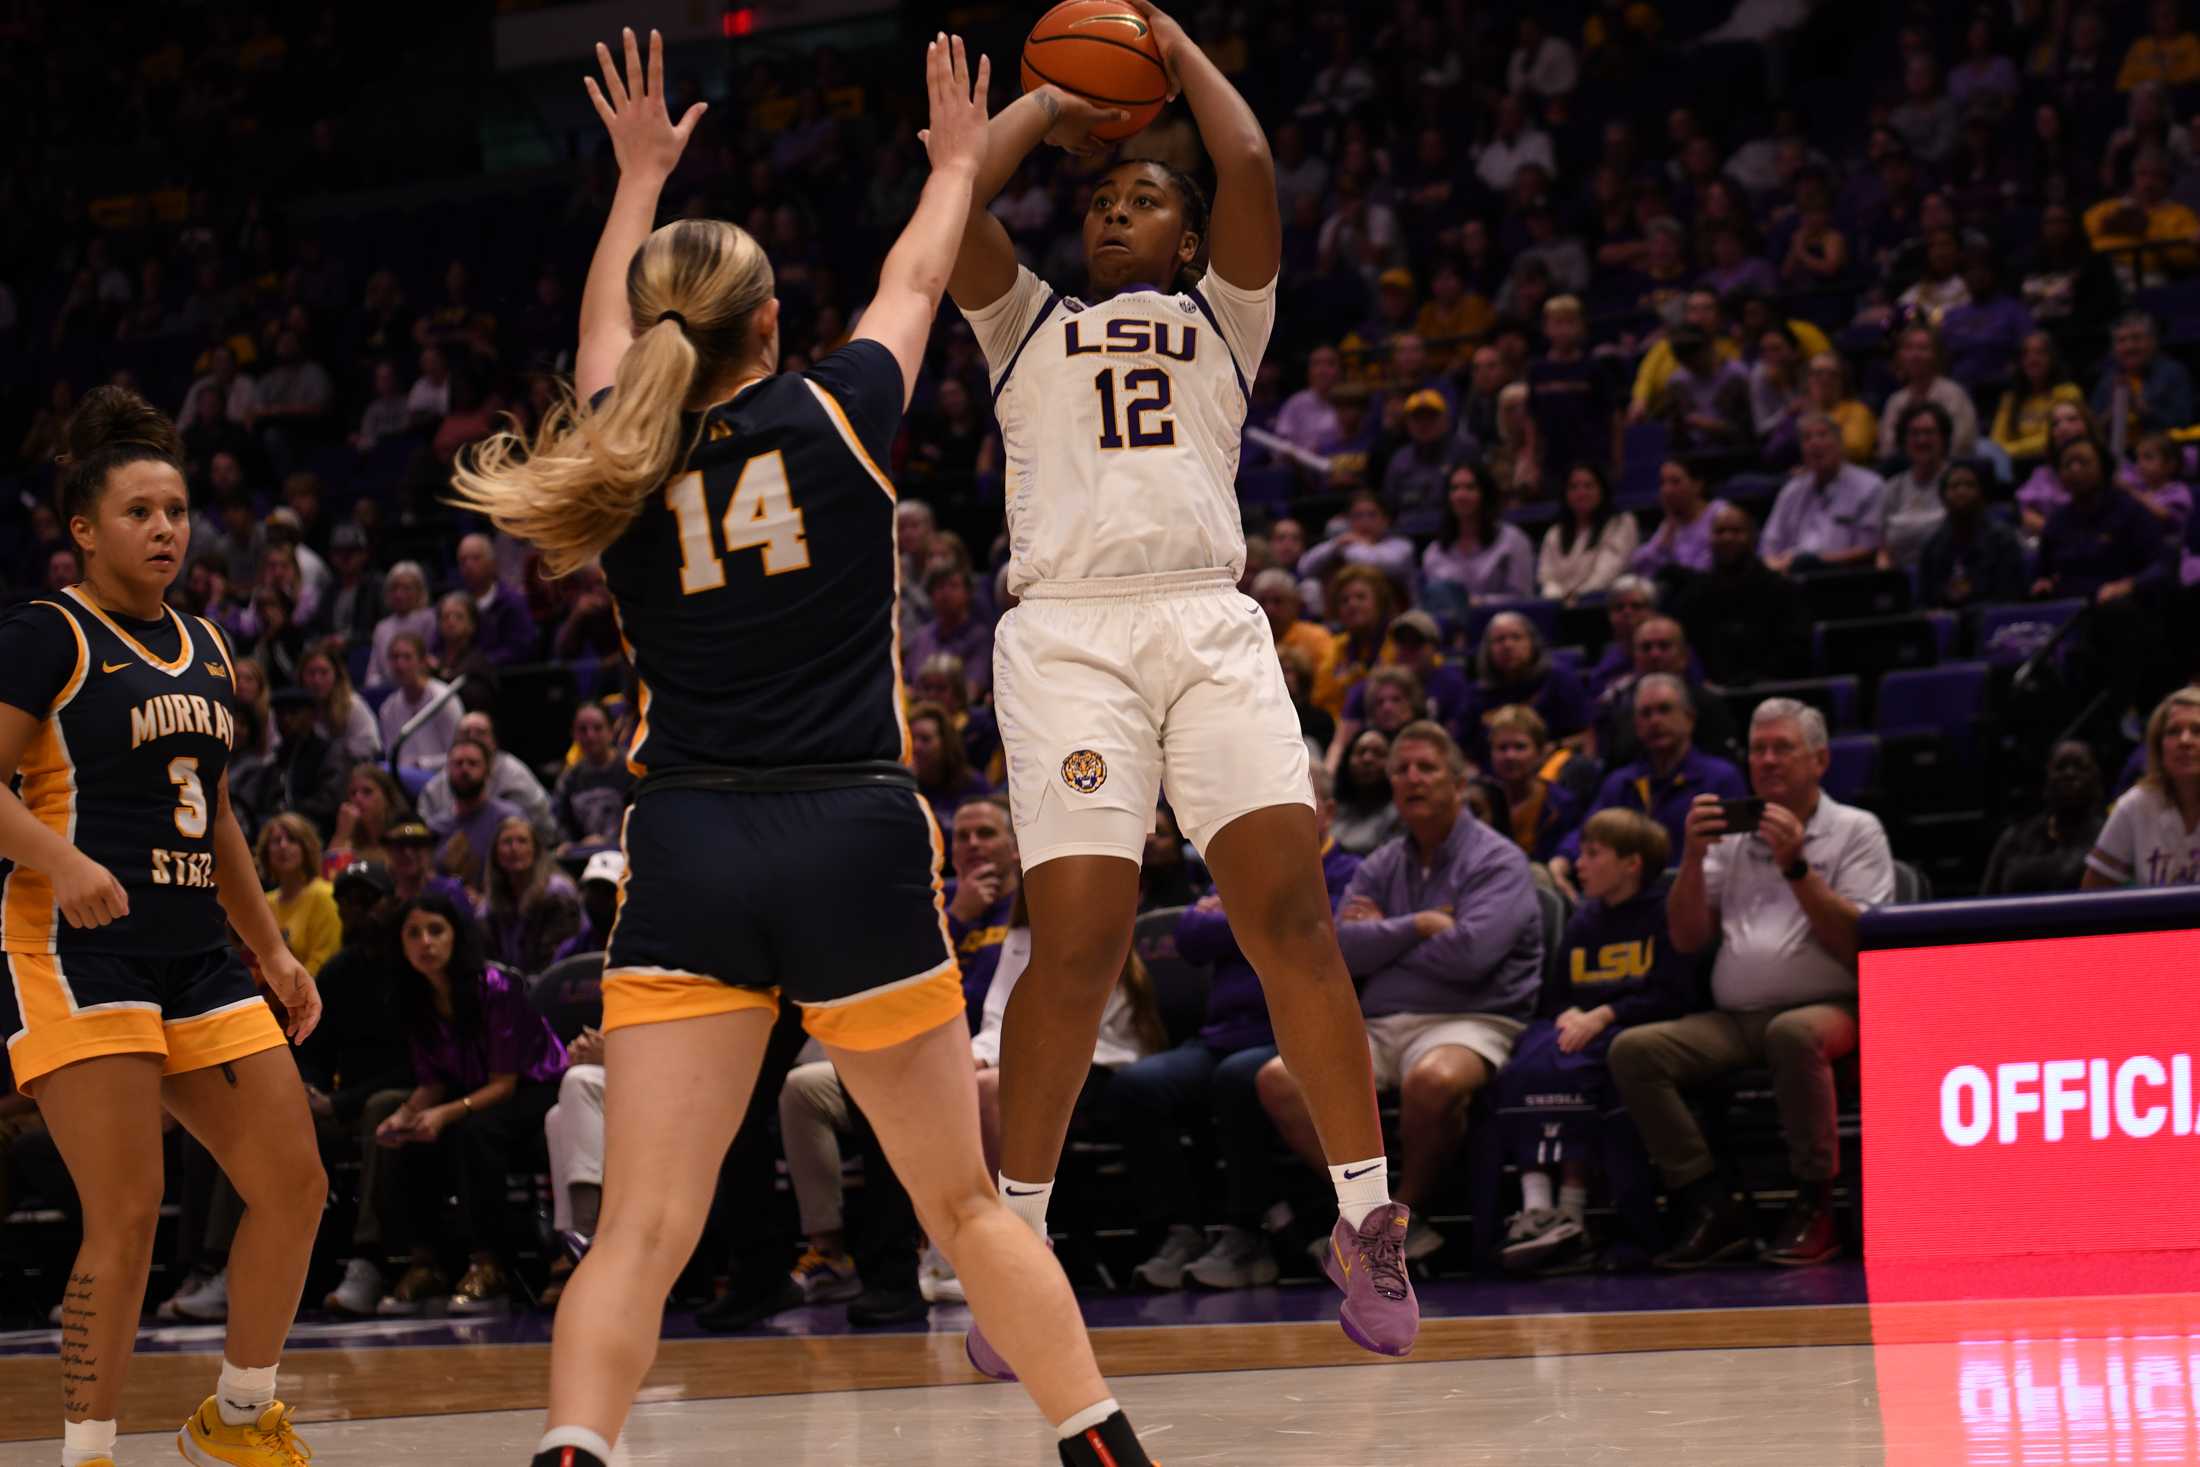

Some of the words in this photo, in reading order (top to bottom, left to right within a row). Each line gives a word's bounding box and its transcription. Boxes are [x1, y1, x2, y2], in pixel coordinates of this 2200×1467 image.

[1064, 318, 1198, 363] LSU
[1094, 367, 1176, 450] 12
[663, 447, 814, 598] 14
[166, 754, 208, 839] 3
[1568, 934, 1657, 985] LSU
[1939, 1053, 2200, 1148] OFFICI
